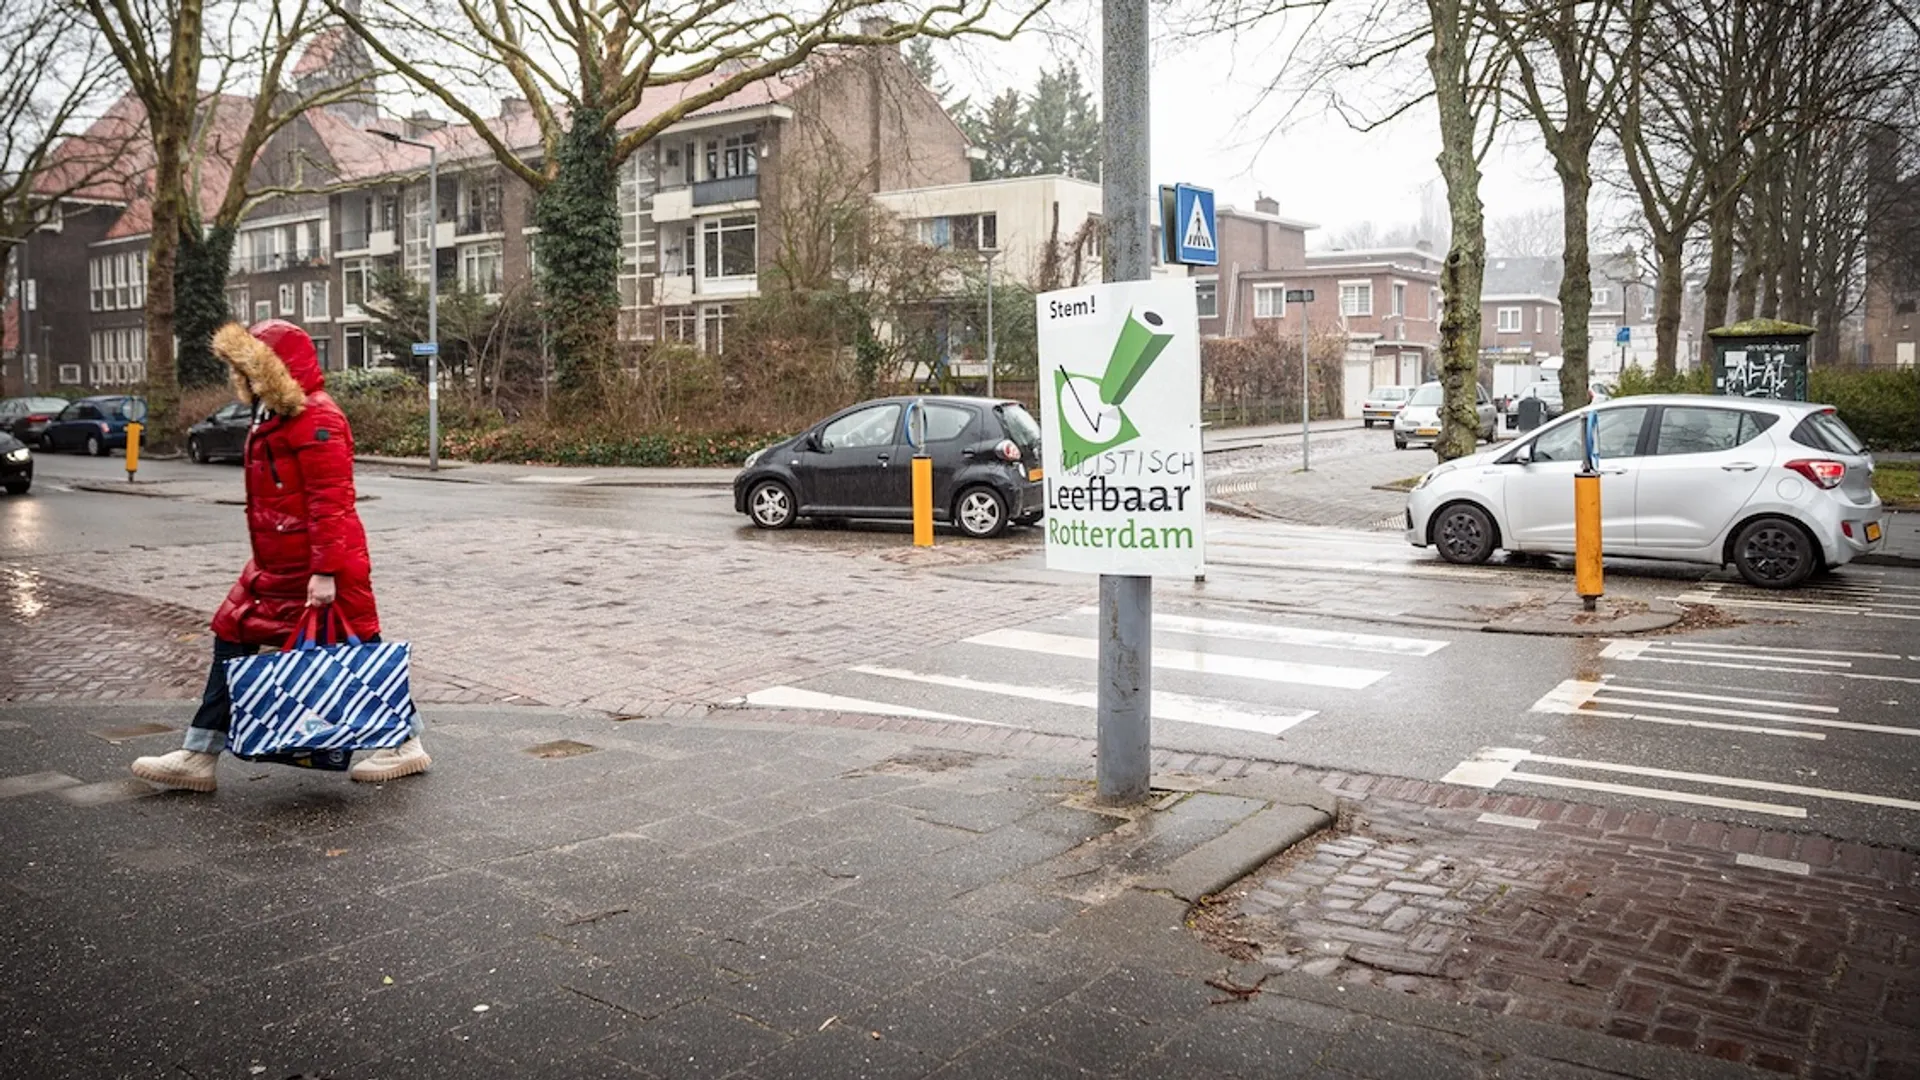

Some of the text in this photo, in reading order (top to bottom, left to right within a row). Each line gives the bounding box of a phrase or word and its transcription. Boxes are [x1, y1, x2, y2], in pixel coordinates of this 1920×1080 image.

[1050, 295, 1096, 319] Stem!
[1048, 475, 1191, 512] Leefbaar
[1049, 517, 1193, 548] Rotterdam
